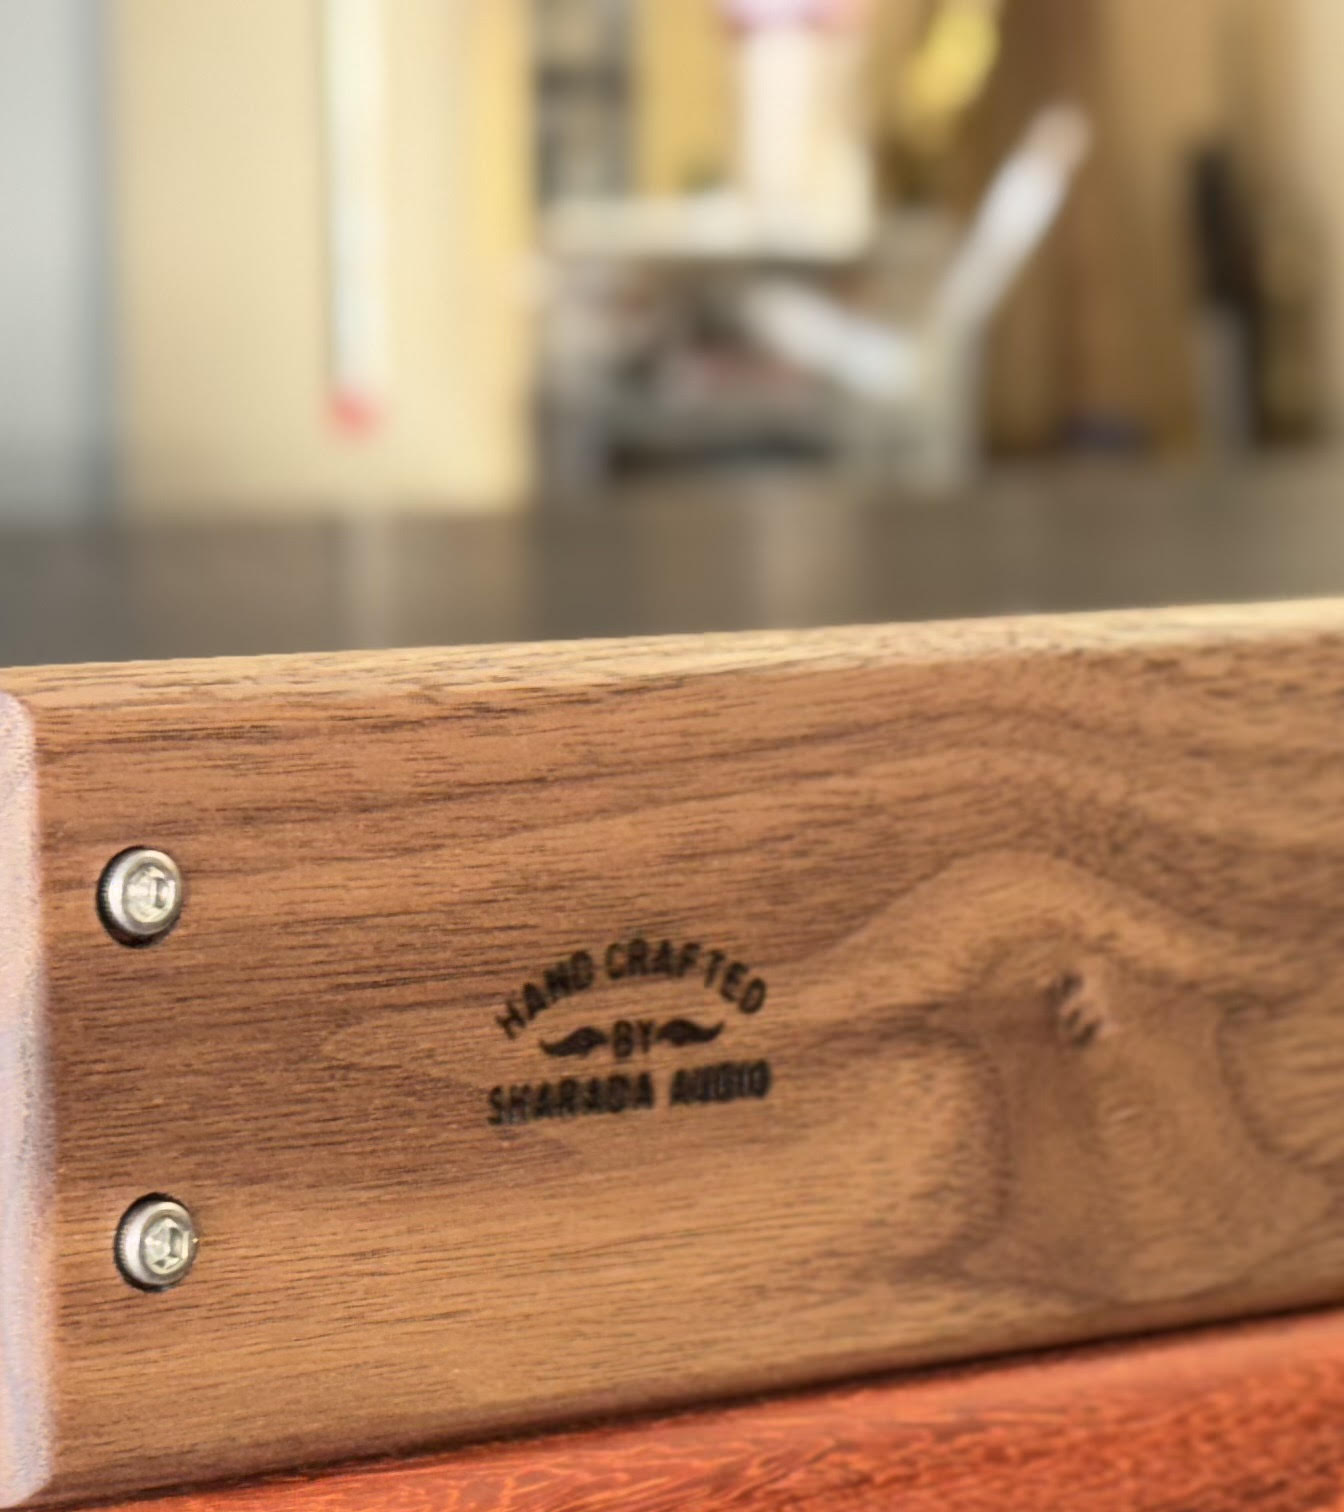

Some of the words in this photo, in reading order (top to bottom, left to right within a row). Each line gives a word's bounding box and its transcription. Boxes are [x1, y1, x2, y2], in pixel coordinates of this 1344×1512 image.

[495, 951, 595, 1039] HAND
[606, 938, 767, 1014] CRAFTED
[613, 1020, 654, 1058] BY
[488, 1072, 654, 1126] SHARADA
[670, 1059, 770, 1106] AUDIO
